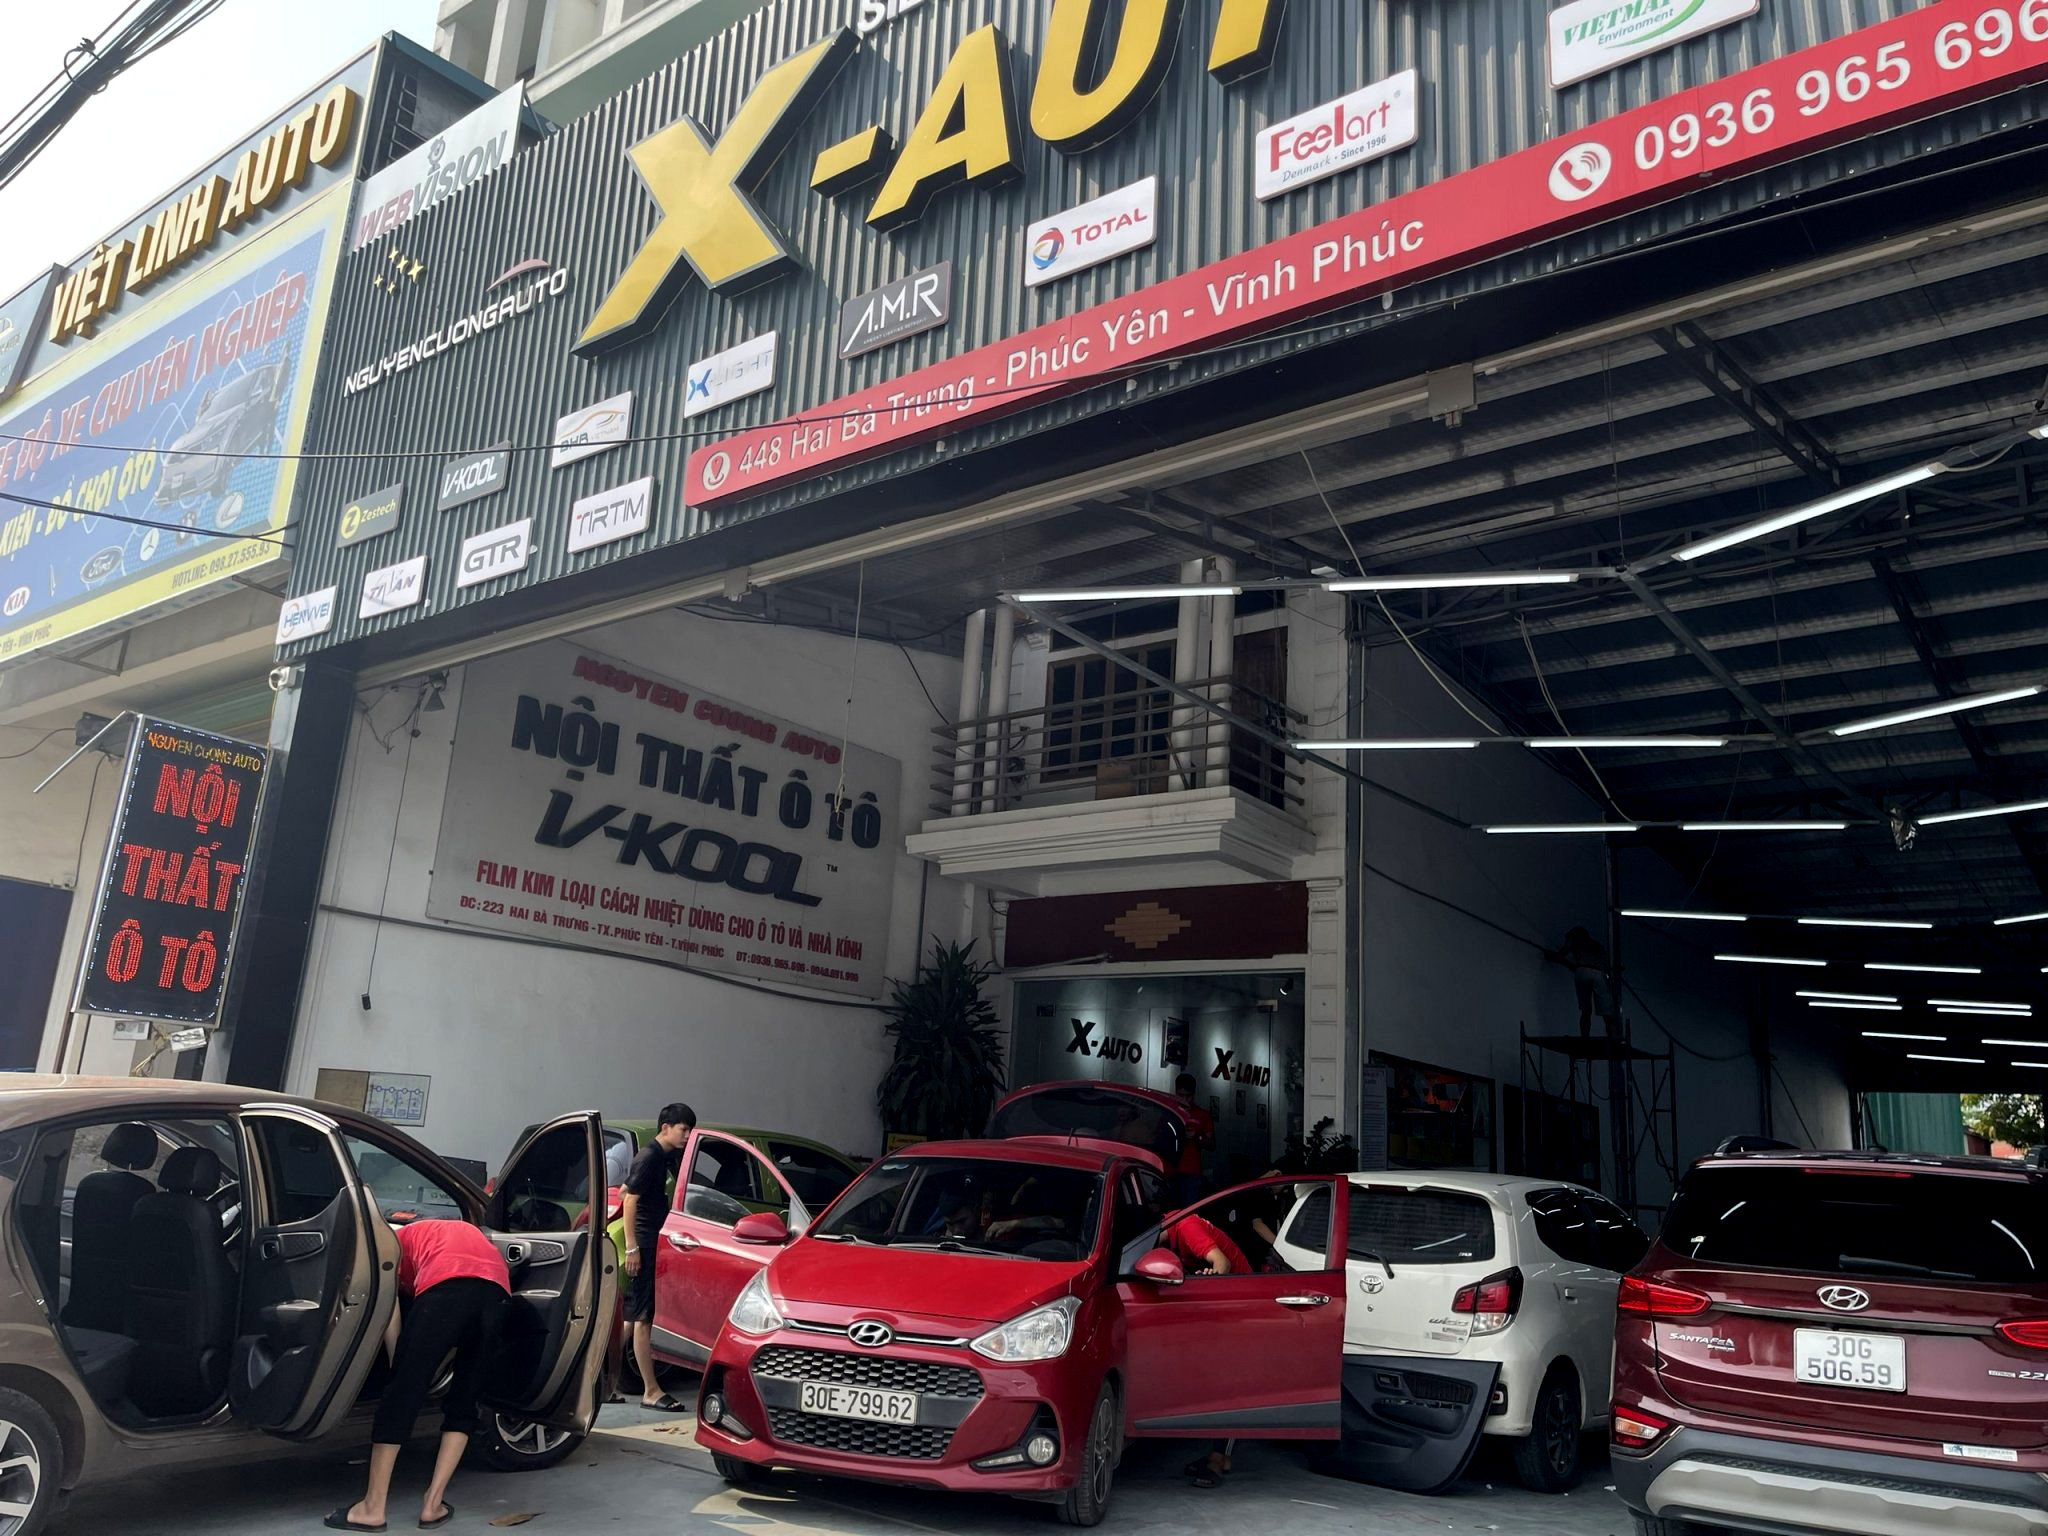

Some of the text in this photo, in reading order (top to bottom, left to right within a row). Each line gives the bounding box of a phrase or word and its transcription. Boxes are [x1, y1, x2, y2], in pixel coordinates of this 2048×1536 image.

[1598, 8, 1674, 45] Environment
[1634, 0, 2048, 170] 0936 965 696
[1270, 97, 1391, 173] Feelart
[1282, 134, 1388, 183] Denmark Since 1996
[50, 84, 364, 342] VIỆT LINH AUTO
[1071, 208, 1148, 246] TOTAL
[343, 268, 568, 398] NGUYENCUONGAUTO
[739, 437, 781, 475] 448
[790, 419, 832, 460] Hai
[841, 402, 877, 439] Bà
[887, 374, 975, 427] Trưng
[1006, 333, 1090, 388] Phúc
[1100, 304, 1168, 354] Yên
[1206, 258, 1296, 318] Vĩnh
[1313, 218, 1425, 284] Phúc
[50, 396, 91, 460] XE
[89, 336, 195, 438] CHUYÊN
[444, 454, 498, 498] V-KOOL
[360, 500, 396, 523] Zestech
[172, 563, 208, 590] HOTLINE:
[463, 534, 522, 574] GTR
[5, 589, 27, 613] KIA
[573, 655, 689, 713] NGUYEN
[781, 730, 842, 765] AUTO
[147, 731, 192, 756] NGUYEN
[233, 751, 261, 772] AUTO
[511, 694, 882, 849] NỘI THẤT Ô TÔ
[153, 763, 242, 835] NỘI
[534, 788, 823, 908] V-KOOL
[122, 841, 241, 912] THẤT
[475, 859, 863, 961] FILM KIM LOẠI CÁCH NHIỆT DÙNG CHO Ô TÔ VÀ NHÀ KÍNH
[509, 905, 529, 920] HAI
[533, 909, 548, 924] BÀ
[552, 913, 590, 932] TRƯNG
[644, 931, 664, 946] YÊN
[701, 943, 725, 958] PHÚC
[106, 918, 218, 992] Ô TÔ
[1066, 1018, 1143, 1064] X-AUTO
[1211, 1047, 1271, 1087] X-LAND
[1807, 1358, 1893, 1386] 506.59
[1826, 1334, 1873, 1360] 30G
[803, 1383, 914, 1422] 30E-799.62
